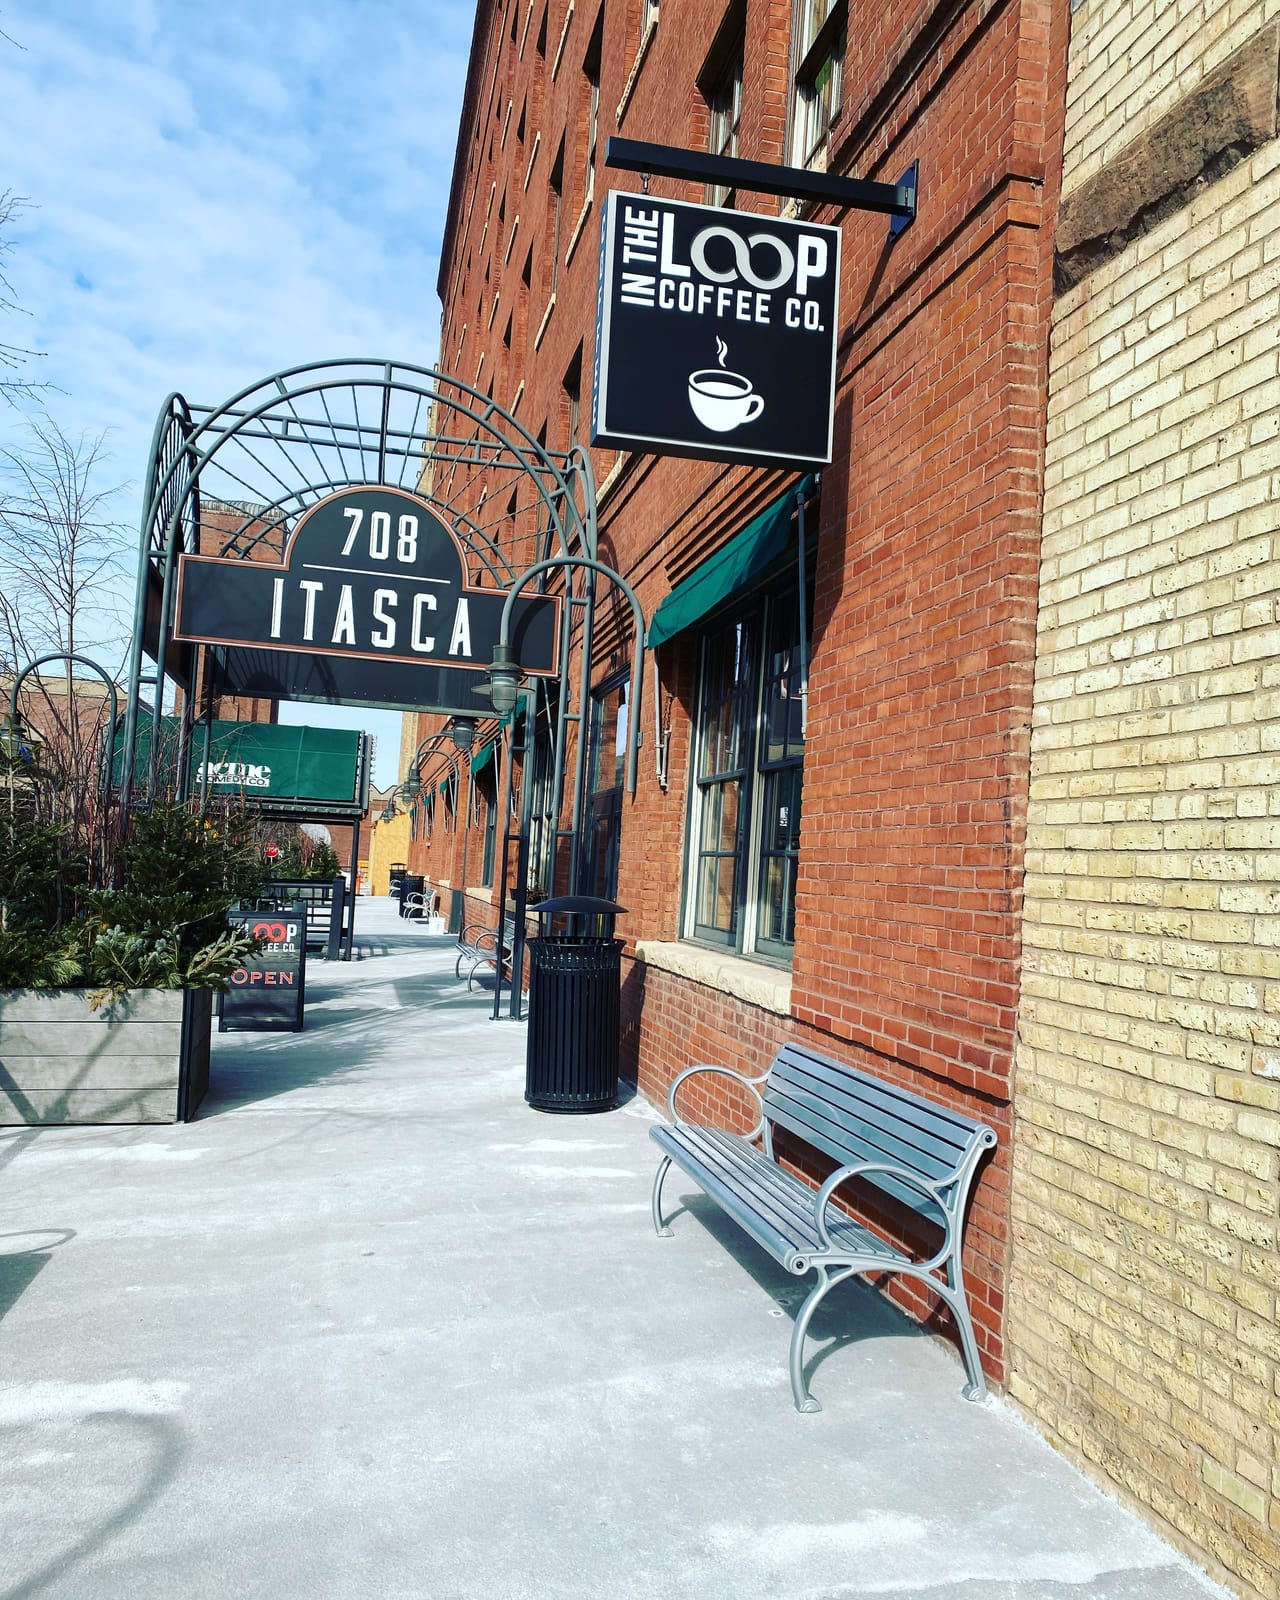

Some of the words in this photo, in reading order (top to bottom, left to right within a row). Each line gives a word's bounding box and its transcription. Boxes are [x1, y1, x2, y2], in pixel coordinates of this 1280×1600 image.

[623, 205, 659, 264] THE
[660, 212, 828, 295] LOOP
[621, 272, 656, 307] IN
[658, 278, 771, 324] COFFEE
[784, 297, 825, 332] CO.
[341, 507, 419, 563] 708
[270, 577, 472, 657] ITASCA
[197, 762, 272, 778] acme
[248, 778, 267, 786] CO.
[230, 968, 294, 985] OPEN
